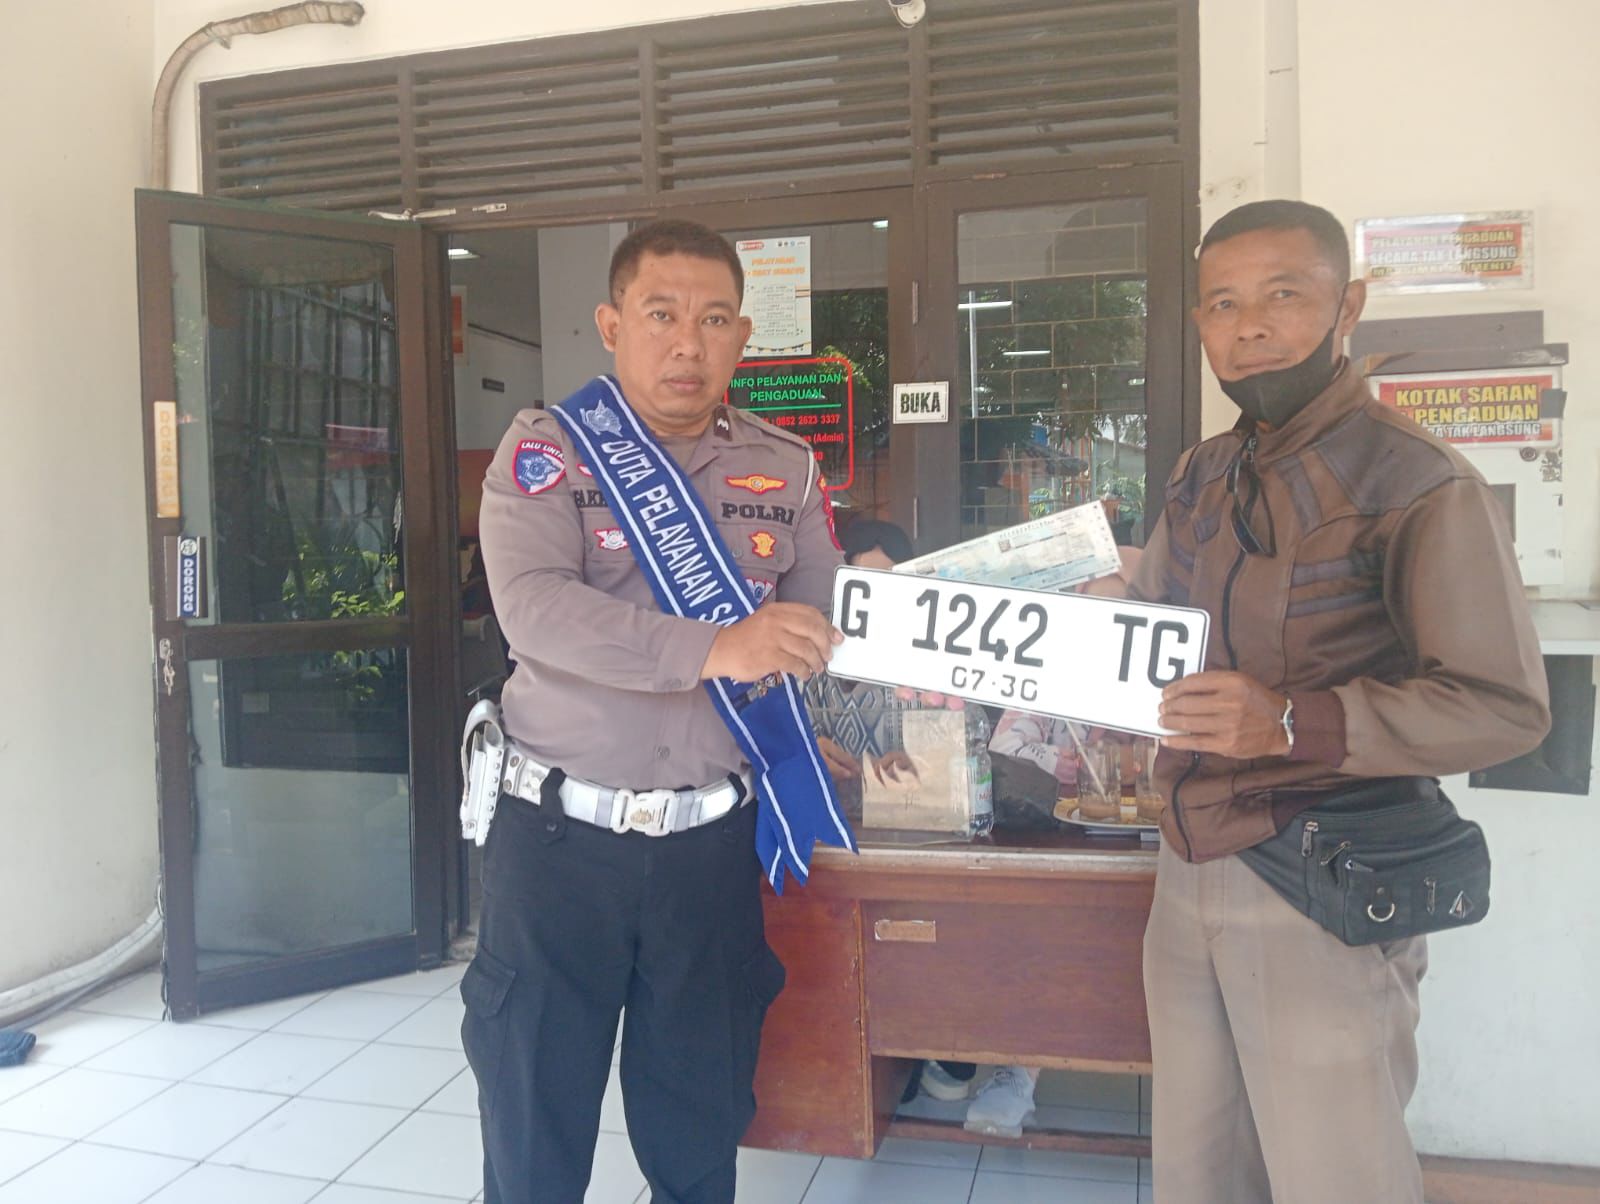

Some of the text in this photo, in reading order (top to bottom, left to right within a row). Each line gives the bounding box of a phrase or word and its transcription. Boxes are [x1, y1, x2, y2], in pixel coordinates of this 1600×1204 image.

[1441, 230, 1515, 246] PENGADUAN
[1448, 246, 1518, 261] LANGSUNG
[730, 373, 842, 388] INFO PELAYANAN DAN
[750, 388, 821, 402] PENGADUAN
[900, 391, 941, 414] BUKA
[1396, 384, 1537, 407] KOTAK SARAN
[1414, 403, 1540, 424] PENGADUAN
[1447, 425, 1472, 438] TAK
[1474, 423, 1541, 437] LANGSUNG
[521, 441, 542, 450] LALU
[601, 440, 656, 489] DUTA
[632, 484, 723, 608] PELAYANAN
[721, 502, 795, 526] POLRI
[183, 558, 195, 612] DORONG
[840, 579, 1190, 688] G 1242 TG
